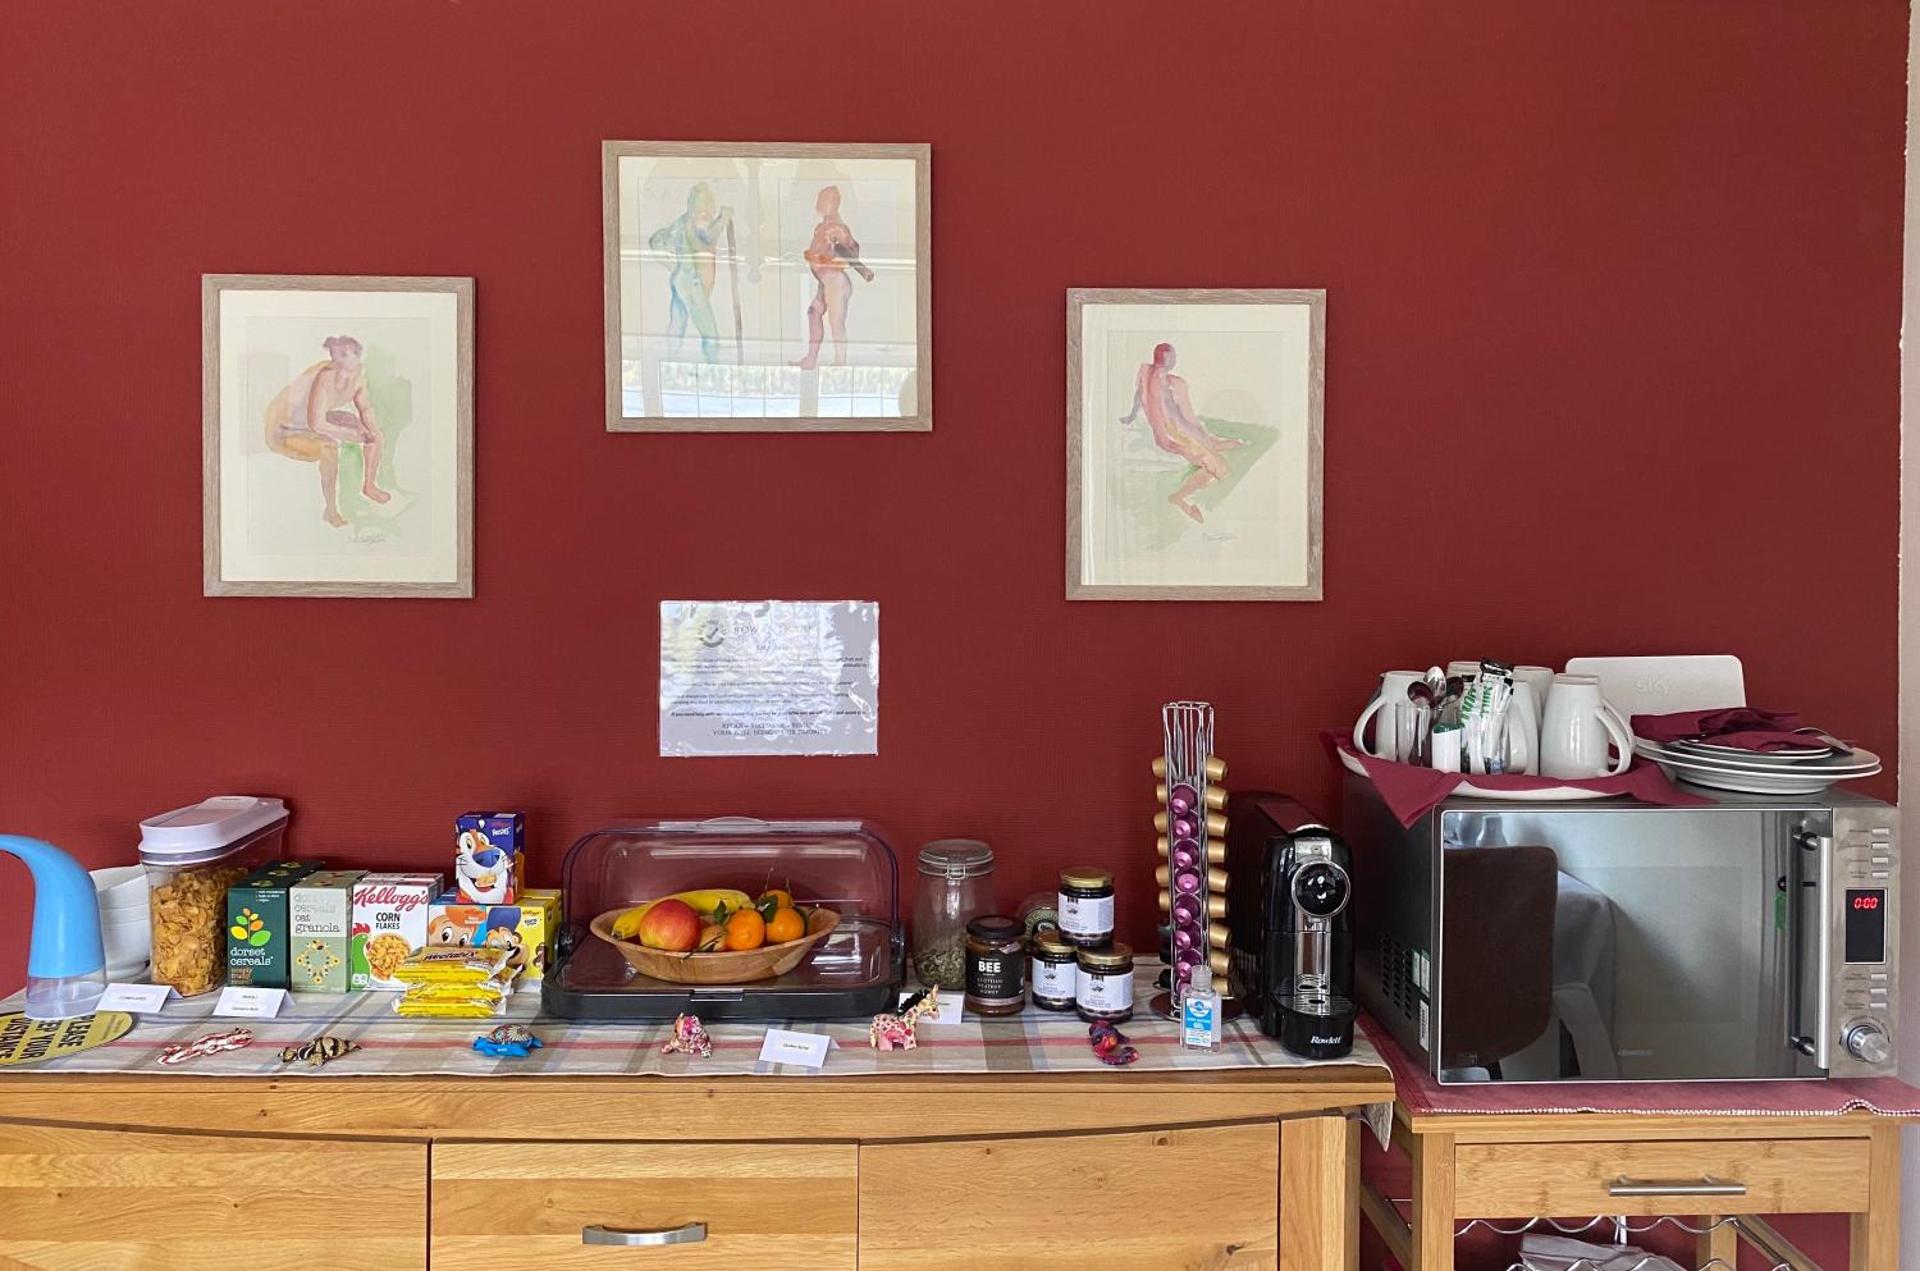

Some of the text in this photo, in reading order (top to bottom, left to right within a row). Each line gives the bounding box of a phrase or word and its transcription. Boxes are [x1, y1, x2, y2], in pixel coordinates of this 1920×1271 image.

[1634, 676, 1674, 697] sky
[353, 885, 431, 912] Kellogg's
[1853, 897, 1878, 909] 0:00
[295, 914, 311, 922] oat
[375, 912, 401, 922] CORN
[295, 922, 341, 934] granola
[375, 922, 400, 930] FLAKES
[230, 946, 266, 956] dorset
[230, 956, 271, 966] cereals
[978, 960, 1001, 973] BEE
